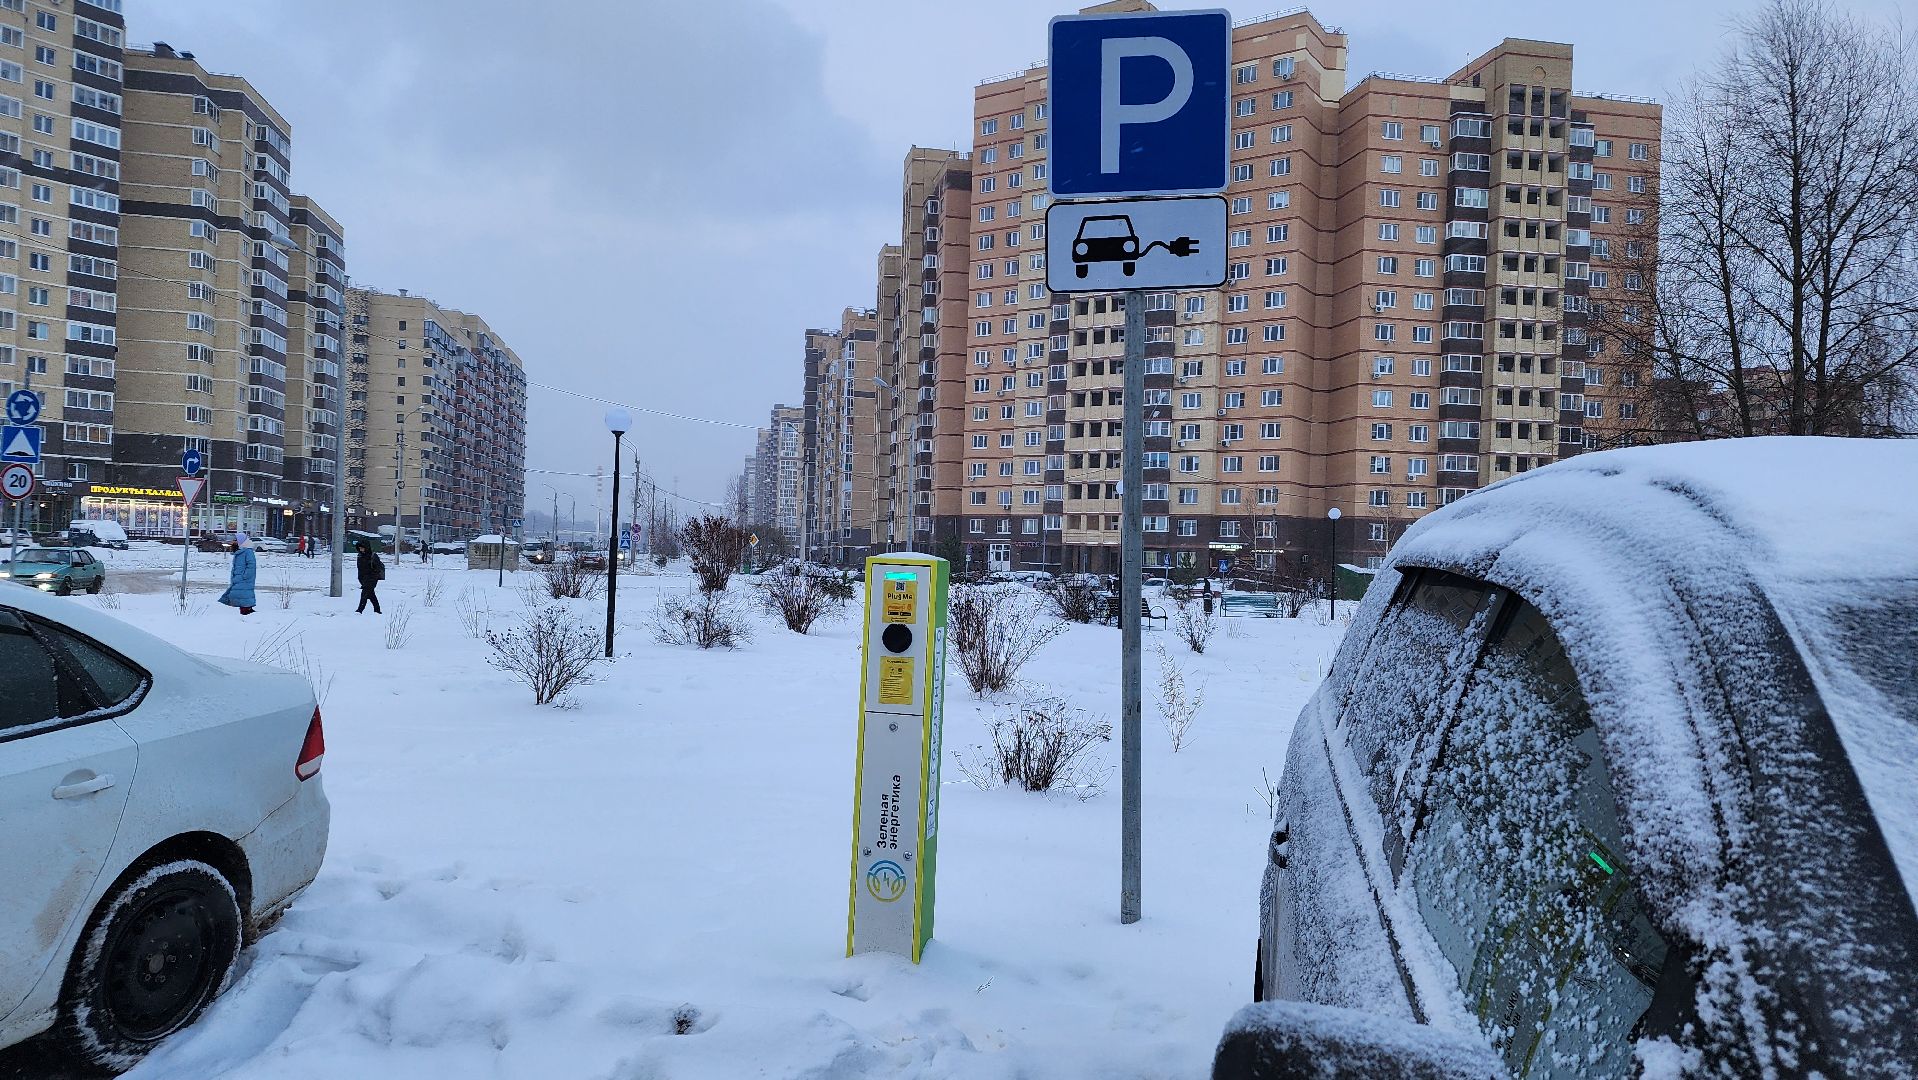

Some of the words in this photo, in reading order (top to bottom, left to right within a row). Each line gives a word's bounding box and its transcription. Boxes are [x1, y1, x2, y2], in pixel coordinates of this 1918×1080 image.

[1101, 36, 1194, 174] P
[9, 474, 27, 488] 20
[90, 485, 144, 495] ПРОДУКТЫ
[877, 793, 889, 849] Зеленая
[889, 774, 901, 850] энергетика
